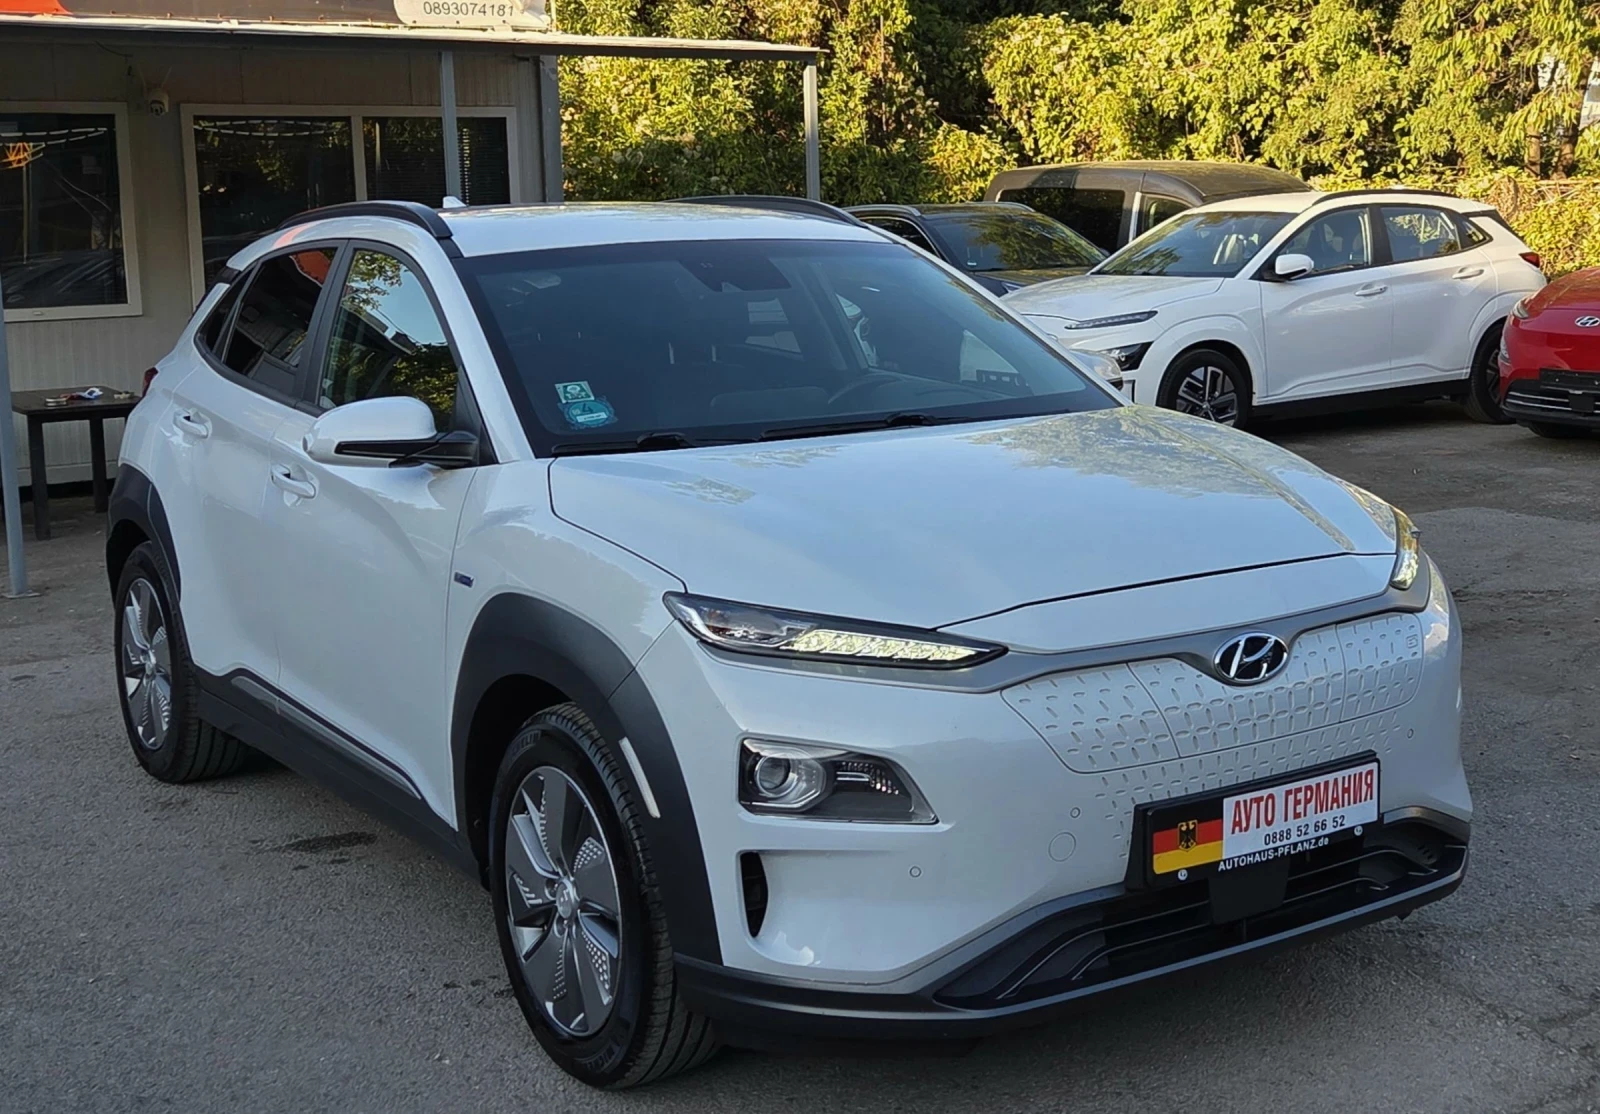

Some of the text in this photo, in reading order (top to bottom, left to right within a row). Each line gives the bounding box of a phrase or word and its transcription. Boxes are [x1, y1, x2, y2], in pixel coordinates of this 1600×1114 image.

[423, 2, 514, 17] 0893074181
[1232, 769, 1374, 834] АУТО ГЕРМАНИЯ
[1264, 814, 1345, 846] 0888 52 66 52
[1218, 837, 1329, 872] AUTOHAUS-PFLANZ.de
